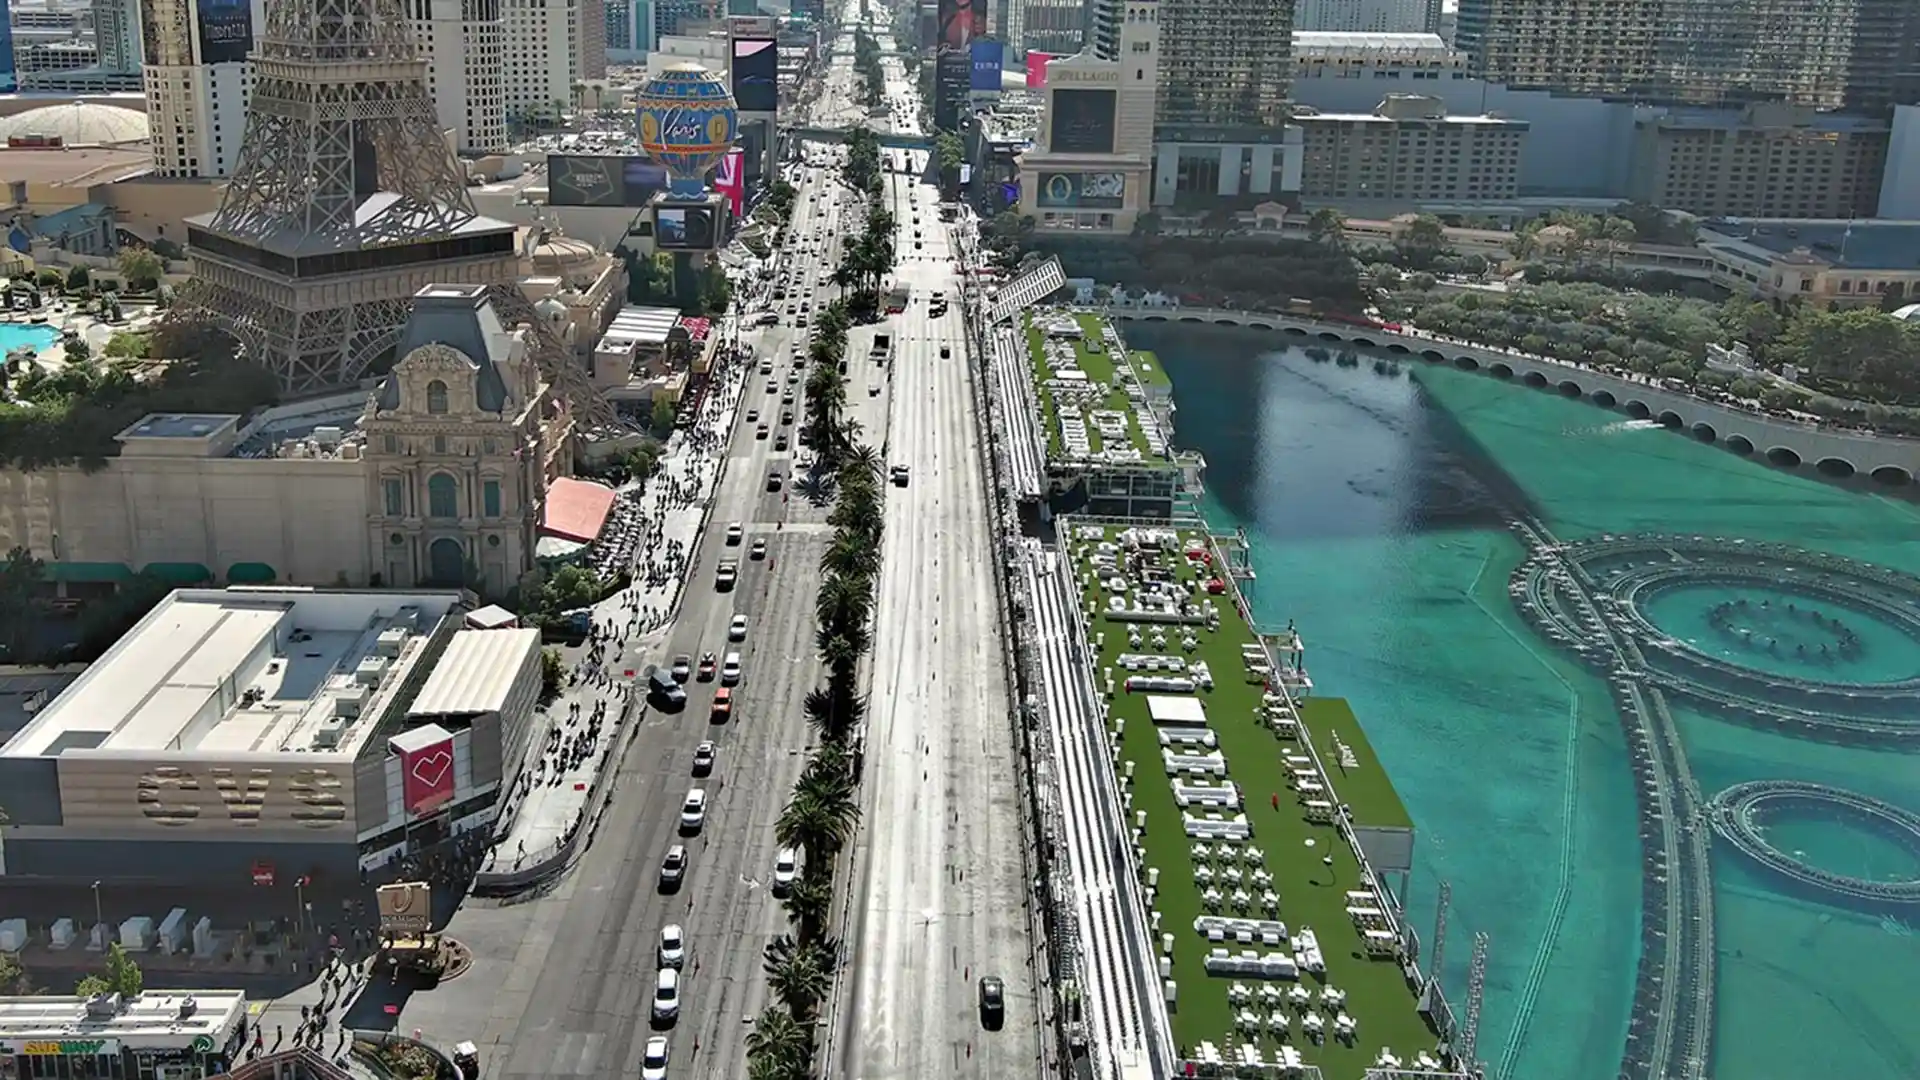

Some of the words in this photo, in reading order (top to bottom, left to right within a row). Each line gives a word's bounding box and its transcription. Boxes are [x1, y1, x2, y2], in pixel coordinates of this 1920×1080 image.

[661, 103, 701, 150] Paris
[137, 766, 346, 828] CVS
[25, 1041, 106, 1054] SUBWAY
